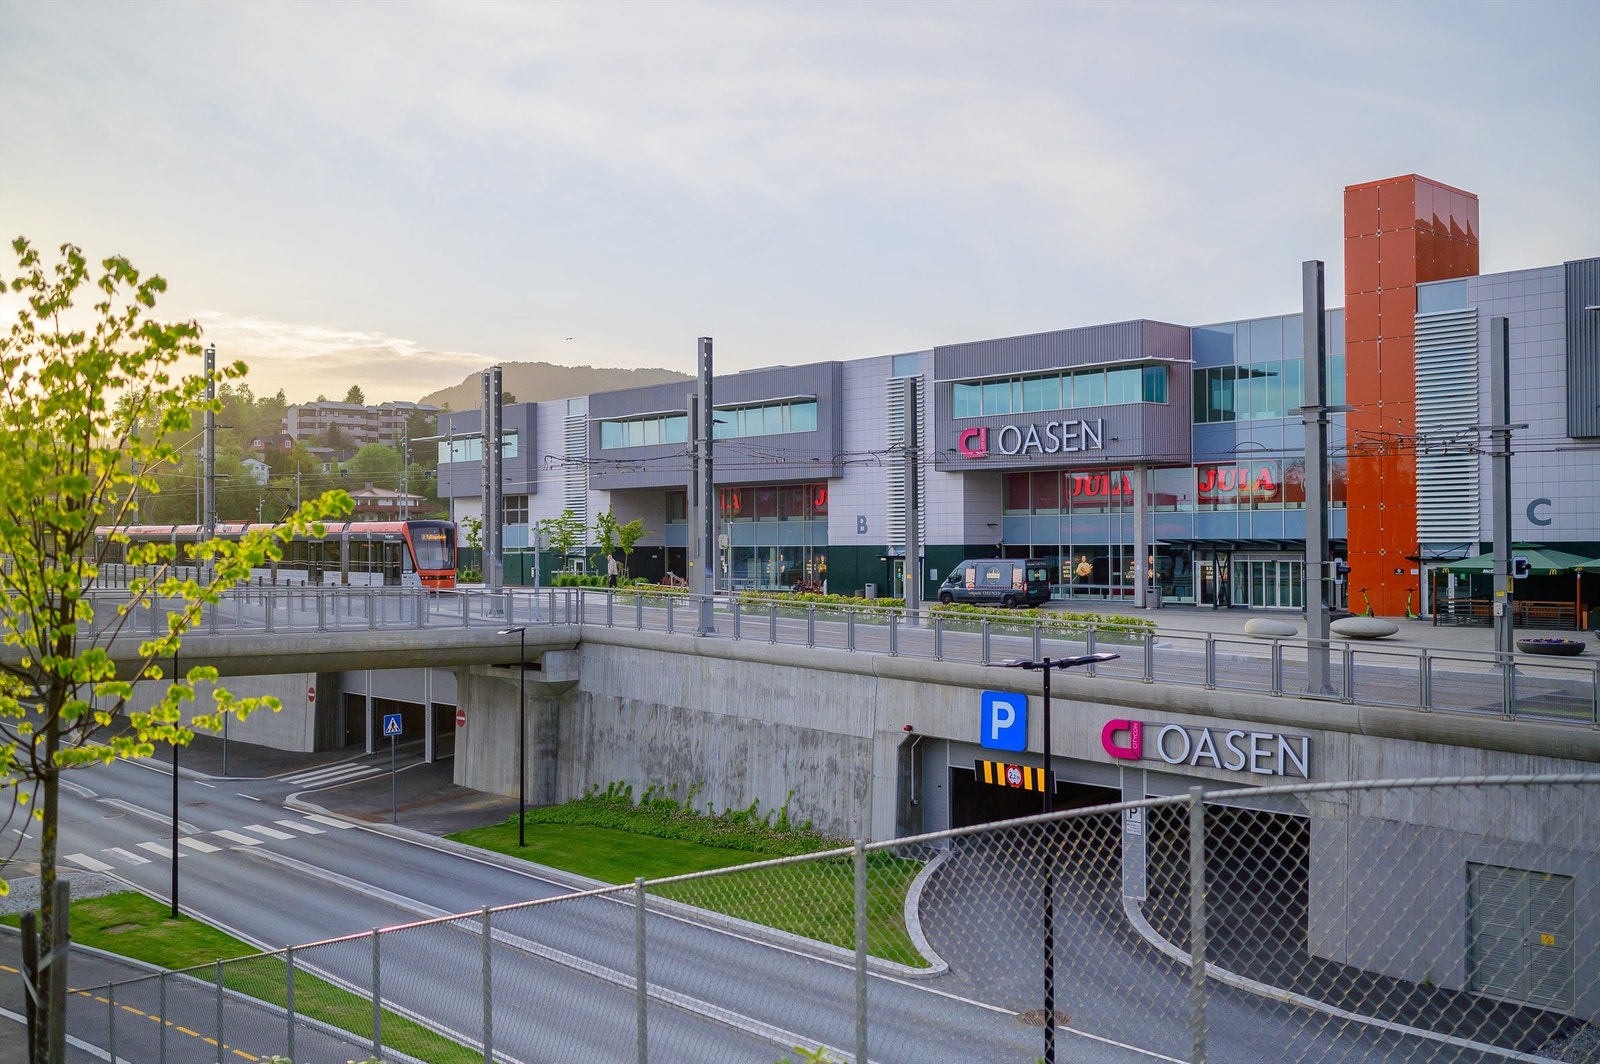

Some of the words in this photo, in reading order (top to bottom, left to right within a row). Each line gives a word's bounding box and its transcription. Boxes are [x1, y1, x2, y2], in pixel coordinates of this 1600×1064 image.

[998, 418, 1103, 455] OASEN
[1072, 472, 1133, 497] JULA
[1198, 467, 1275, 492] JULA
[856, 515, 868, 534] B
[1526, 498, 1552, 526] C
[991, 700, 1016, 740] P
[1157, 724, 1309, 779] OASEN
[1129, 807, 1138, 819] P
